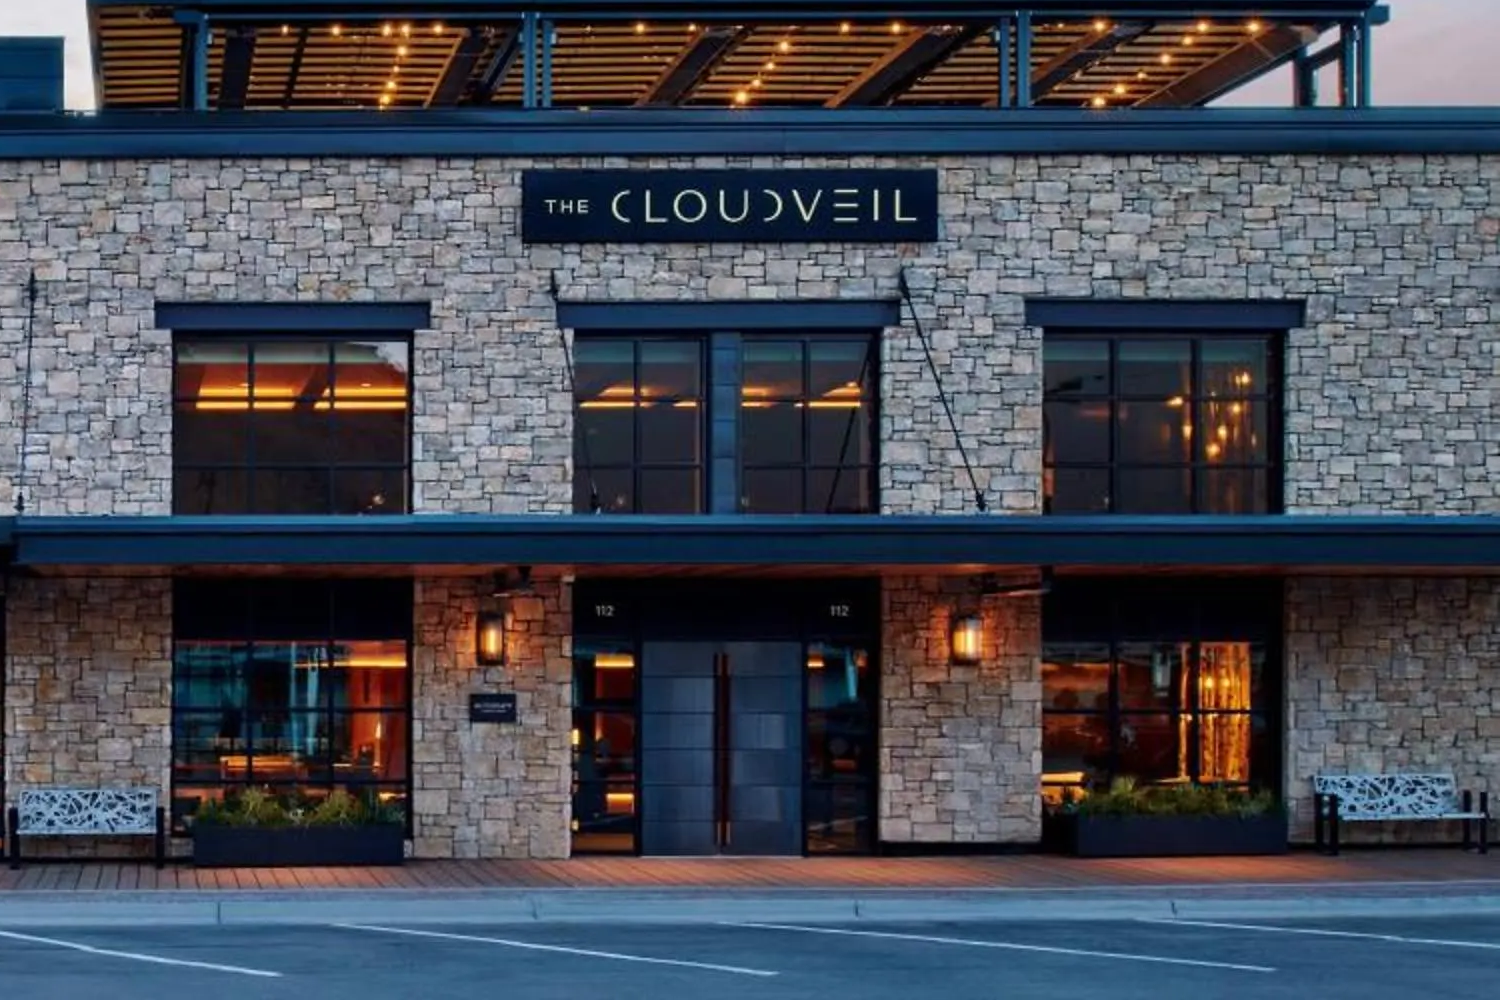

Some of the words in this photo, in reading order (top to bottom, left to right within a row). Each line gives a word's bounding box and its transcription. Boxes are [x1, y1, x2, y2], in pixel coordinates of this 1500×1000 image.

[544, 199, 589, 214] THE
[611, 188, 917, 223] CLOUDVEIL
[595, 605, 614, 617] 112
[830, 605, 849, 617] 112
